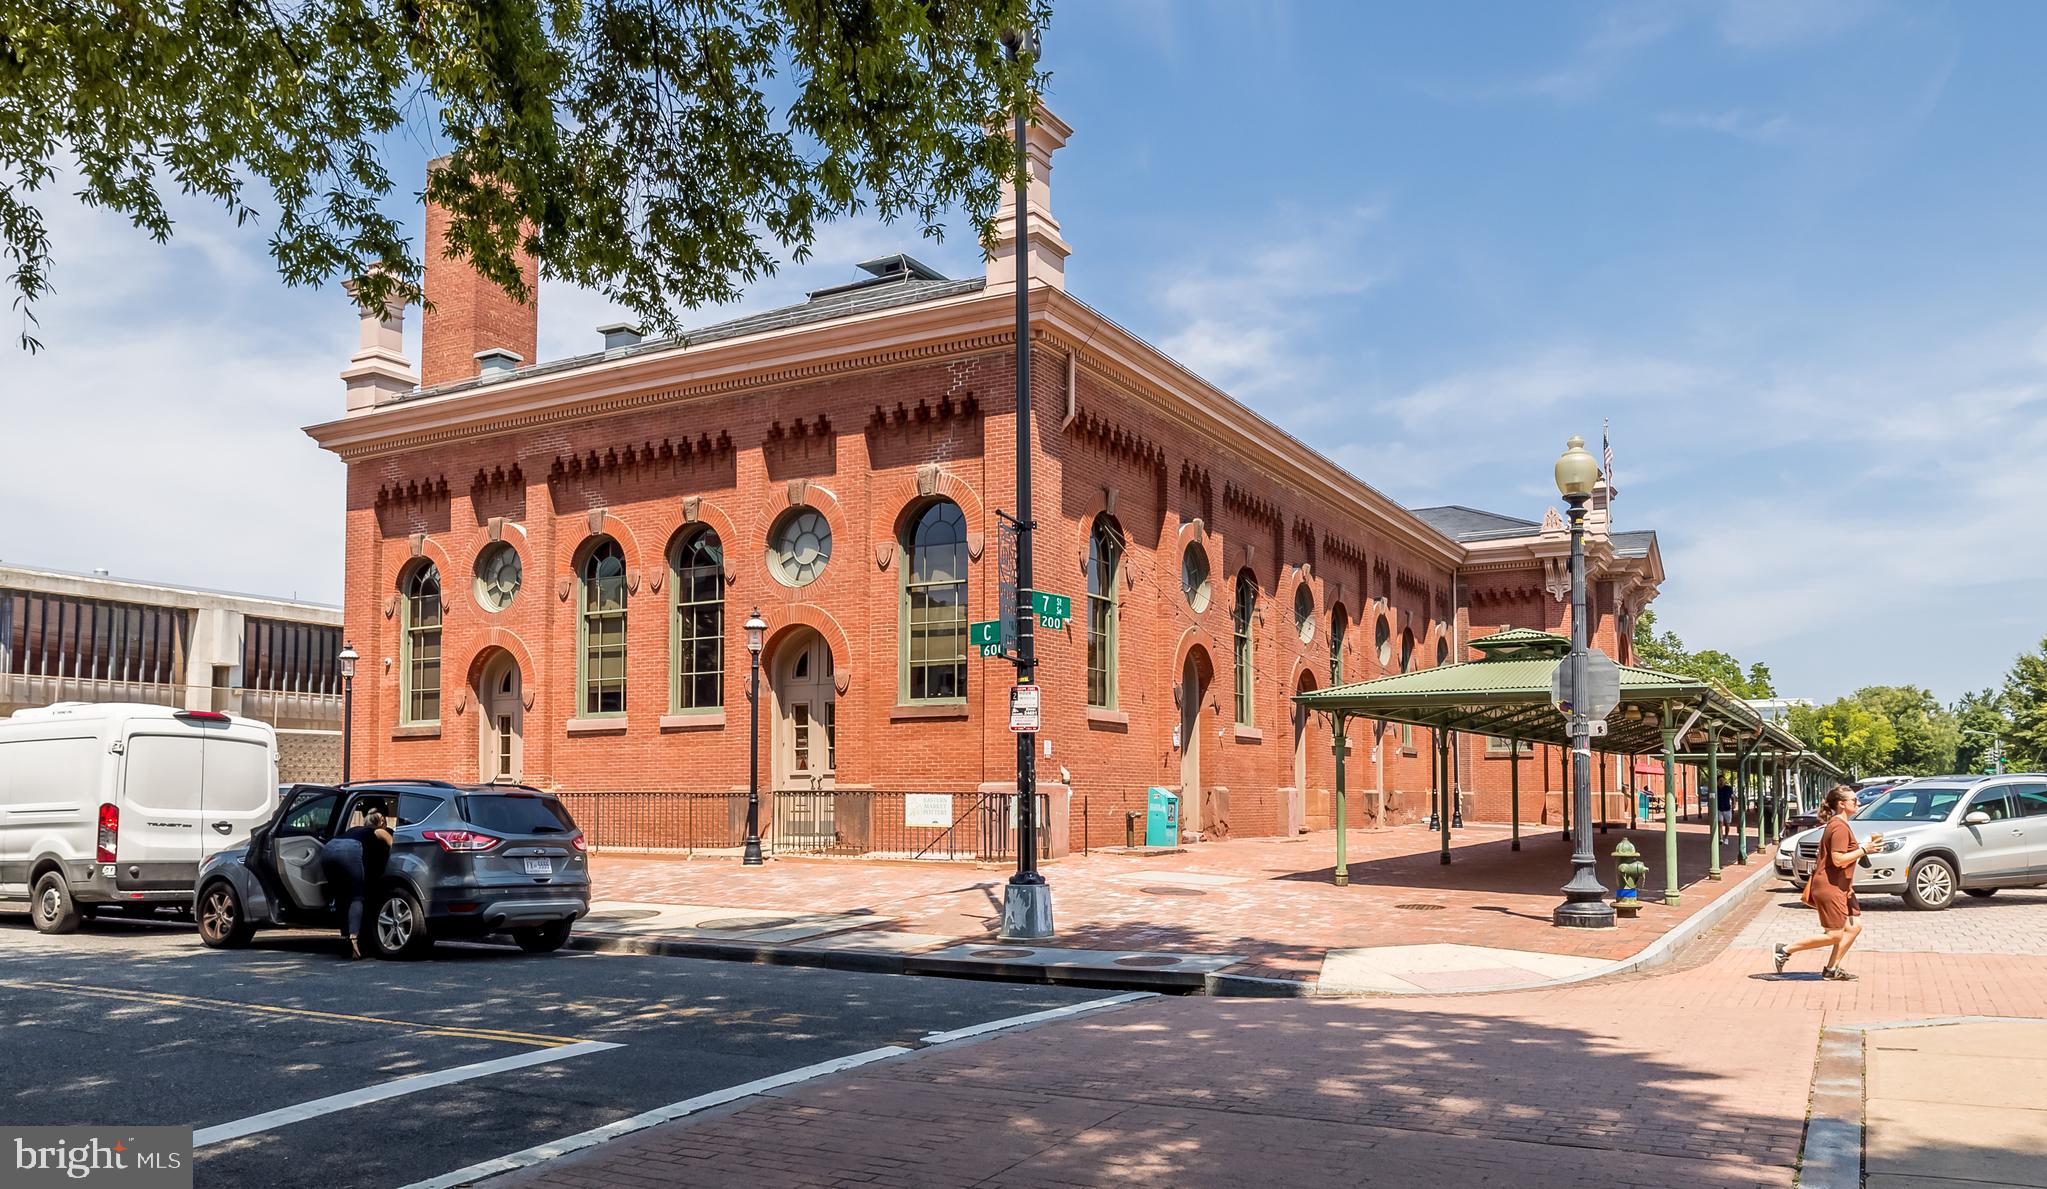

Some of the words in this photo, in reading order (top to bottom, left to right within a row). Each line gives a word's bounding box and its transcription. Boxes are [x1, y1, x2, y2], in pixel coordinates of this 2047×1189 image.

[1042, 595, 1049, 612] 7
[1042, 615, 1060, 628] 200
[983, 624, 992, 641] C
[1012, 692, 1017, 700] 2
